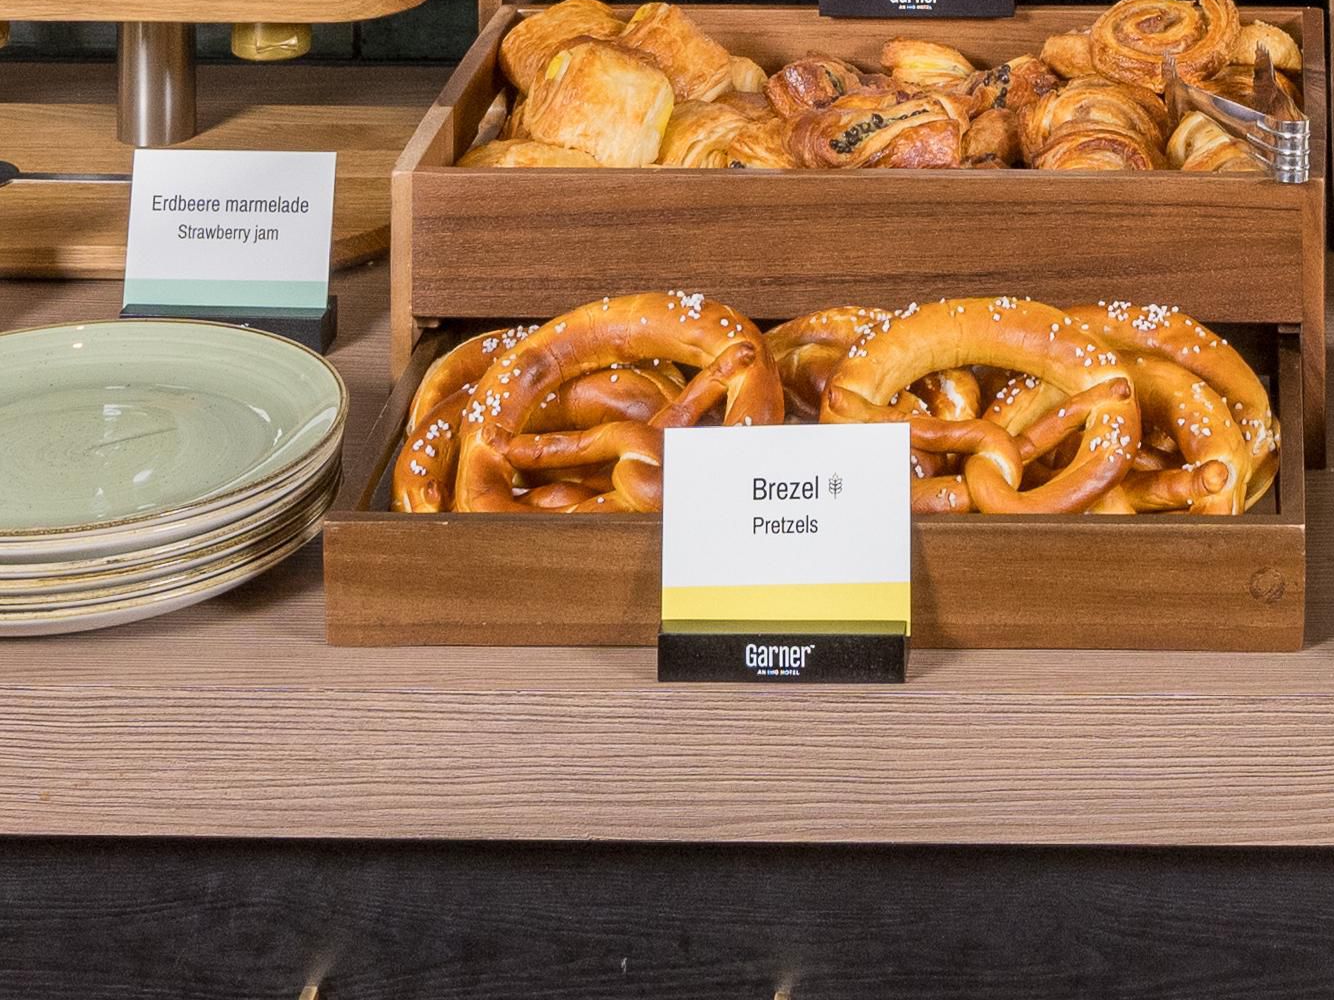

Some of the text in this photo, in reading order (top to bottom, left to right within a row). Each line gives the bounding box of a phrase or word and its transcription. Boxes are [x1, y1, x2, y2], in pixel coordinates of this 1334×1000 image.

[152, 194, 309, 214] Erdbeere marmelade
[177, 223, 279, 244] Strawberry jam
[752, 475, 819, 501] Brezel
[752, 514, 819, 535] Pretzels
[745, 643, 812, 668] Garner
